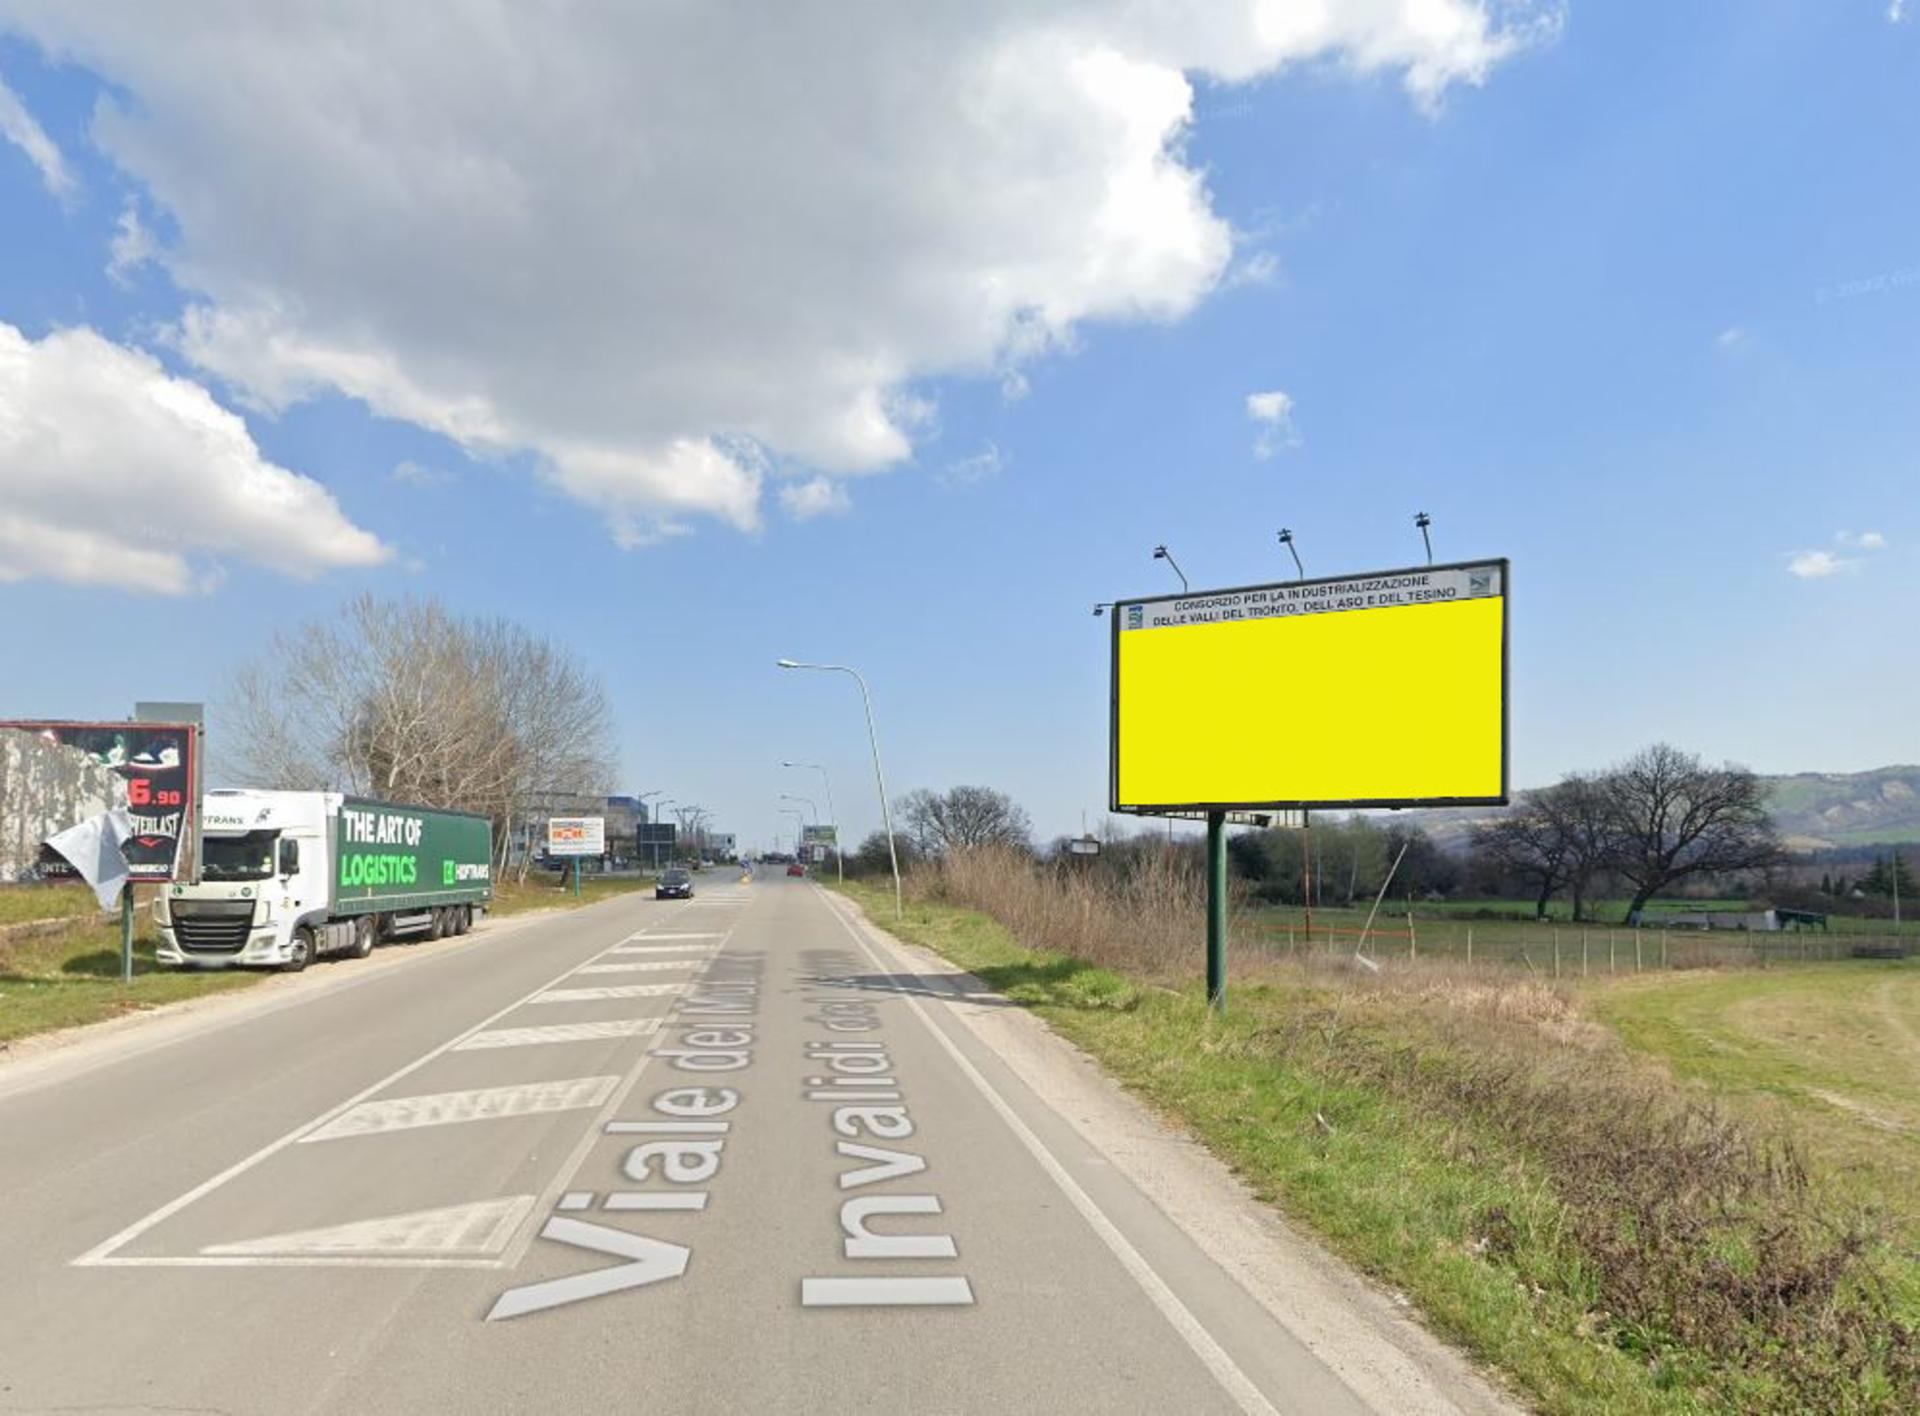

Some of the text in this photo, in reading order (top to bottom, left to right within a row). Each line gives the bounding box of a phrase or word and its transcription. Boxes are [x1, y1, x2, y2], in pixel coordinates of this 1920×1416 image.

[1153, 615, 1187, 627] DELLE
[1190, 612, 1219, 624] VALLI
[1223, 609, 1244, 621] DEL
[1368, 594, 1375, 605] E
[1379, 591, 1402, 604] DEL
[1408, 587, 1456, 601] TESINO
[1174, 595, 1241, 612] CONSORZIO
[1244, 592, 1267, 604] PER
[1271, 590, 1285, 601] LA
[343, 810, 423, 846] THE ART OF
[341, 854, 417, 886] LOGISTICS
